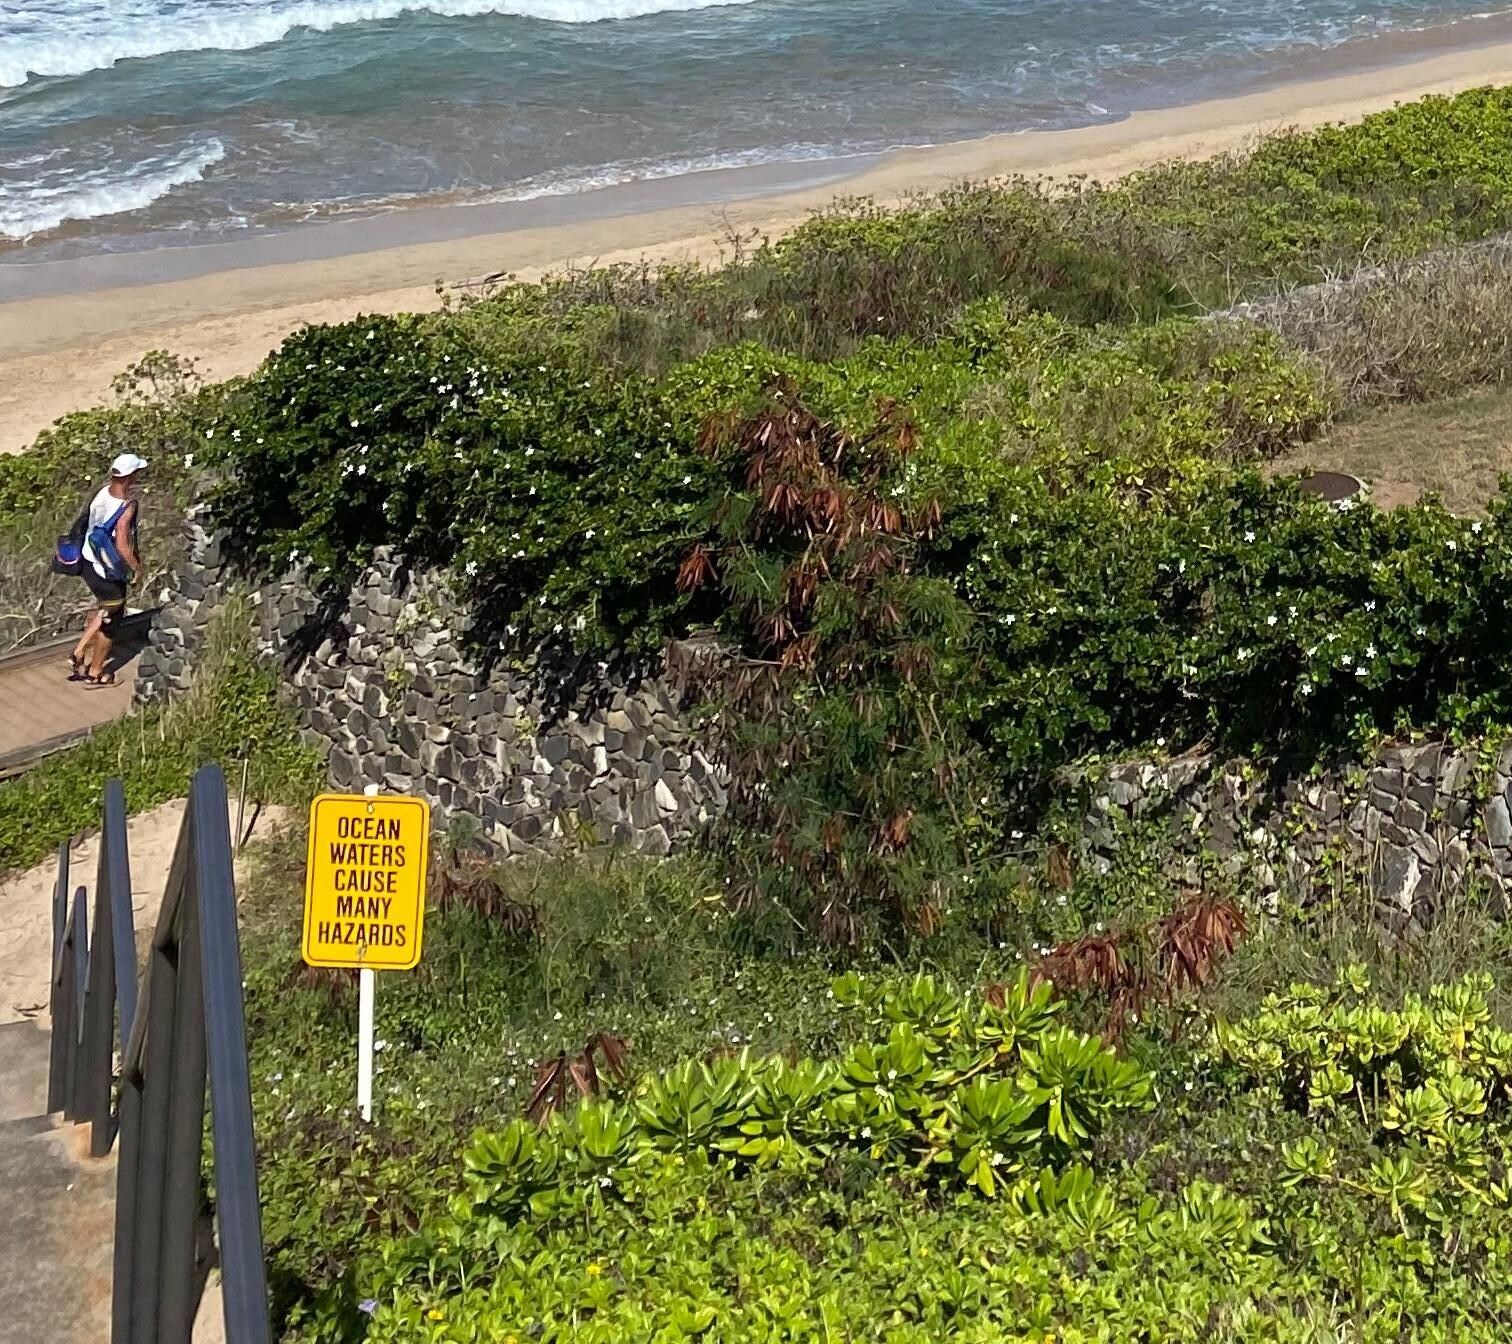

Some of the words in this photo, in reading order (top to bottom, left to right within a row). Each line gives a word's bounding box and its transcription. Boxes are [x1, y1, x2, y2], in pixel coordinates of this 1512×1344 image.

[338, 816, 400, 841] OCEAN
[330, 843, 406, 867] WATERS
[334, 869, 398, 893] CAUSE
[336, 896, 392, 920] MANY
[318, 922, 406, 947] HAZARDS
